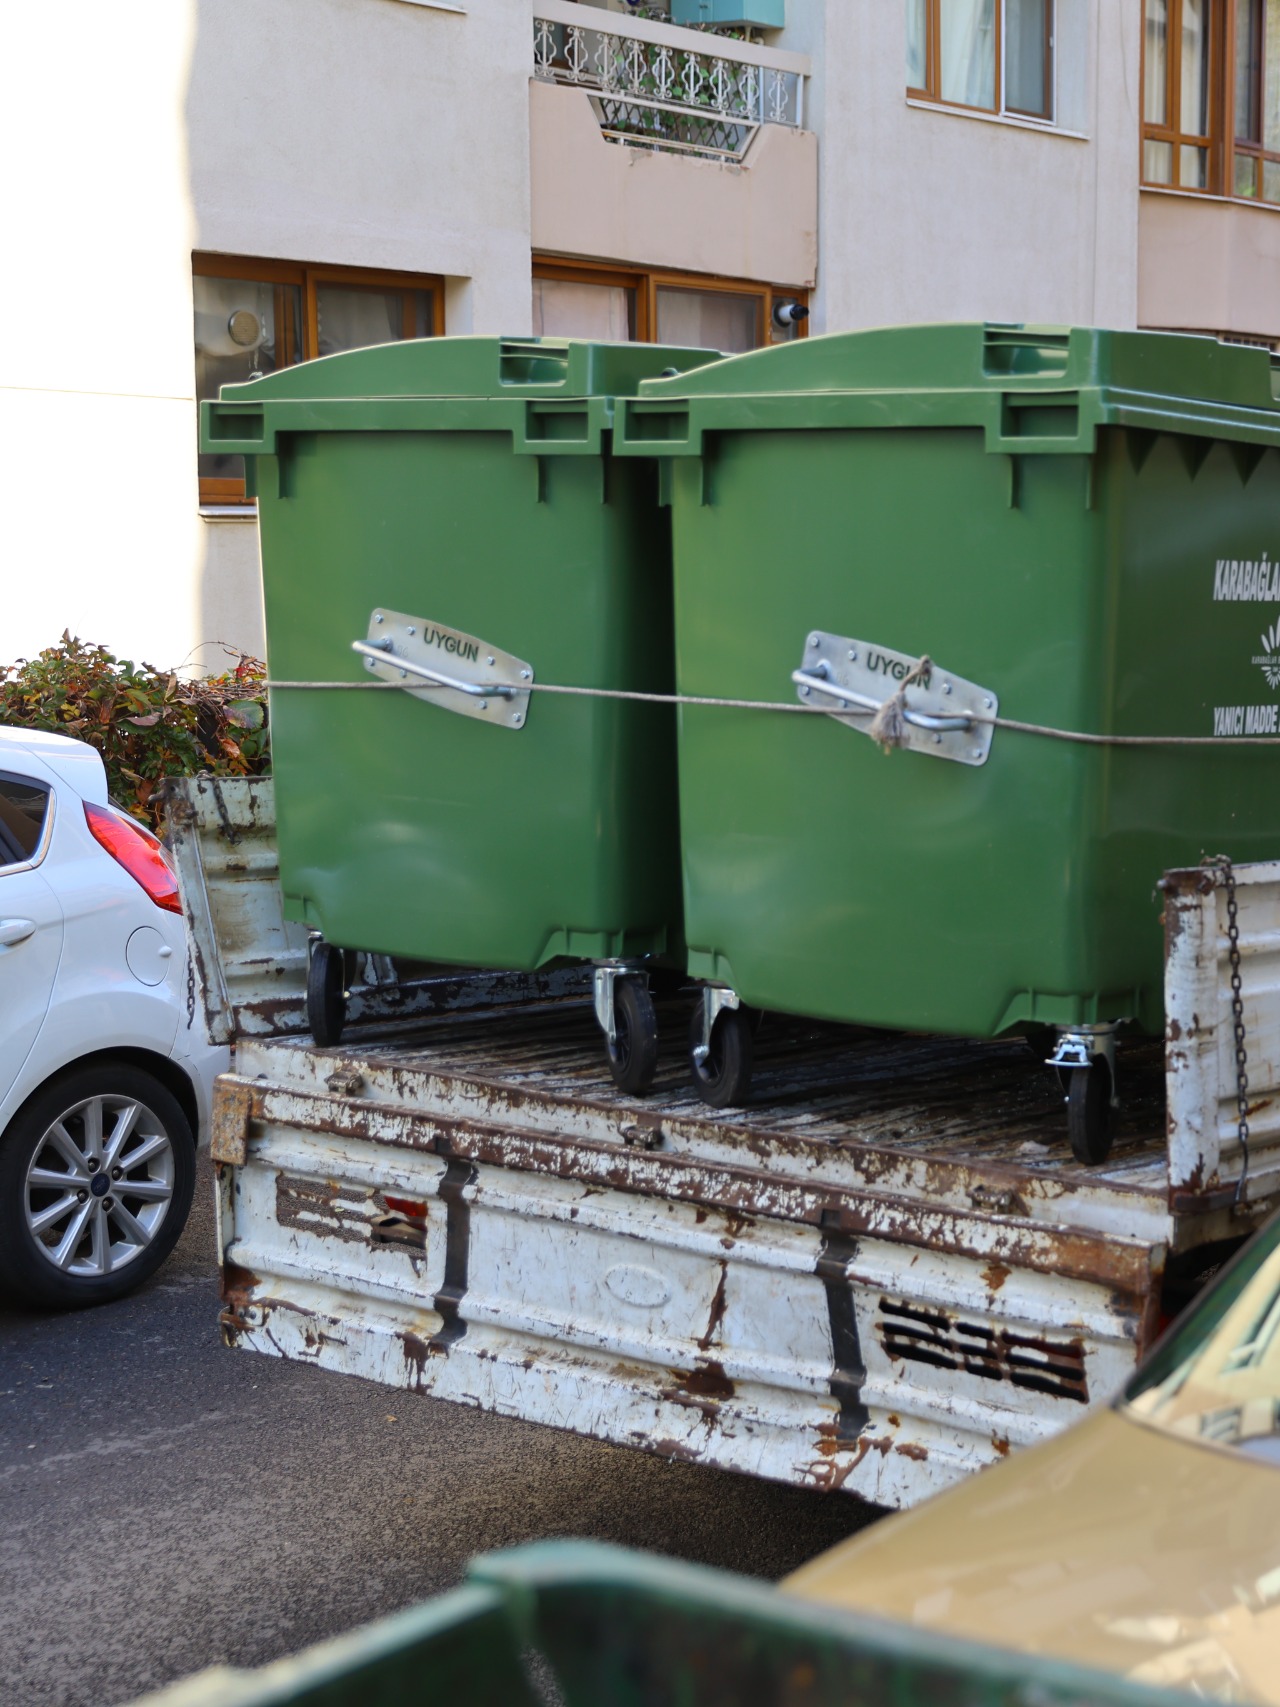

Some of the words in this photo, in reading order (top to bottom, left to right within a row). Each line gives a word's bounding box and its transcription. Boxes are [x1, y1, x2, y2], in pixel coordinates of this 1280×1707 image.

[423, 627, 479, 663] UYGUN
[1214, 706, 1245, 736] YANICI
[1245, 705, 1279, 734] MADDE
